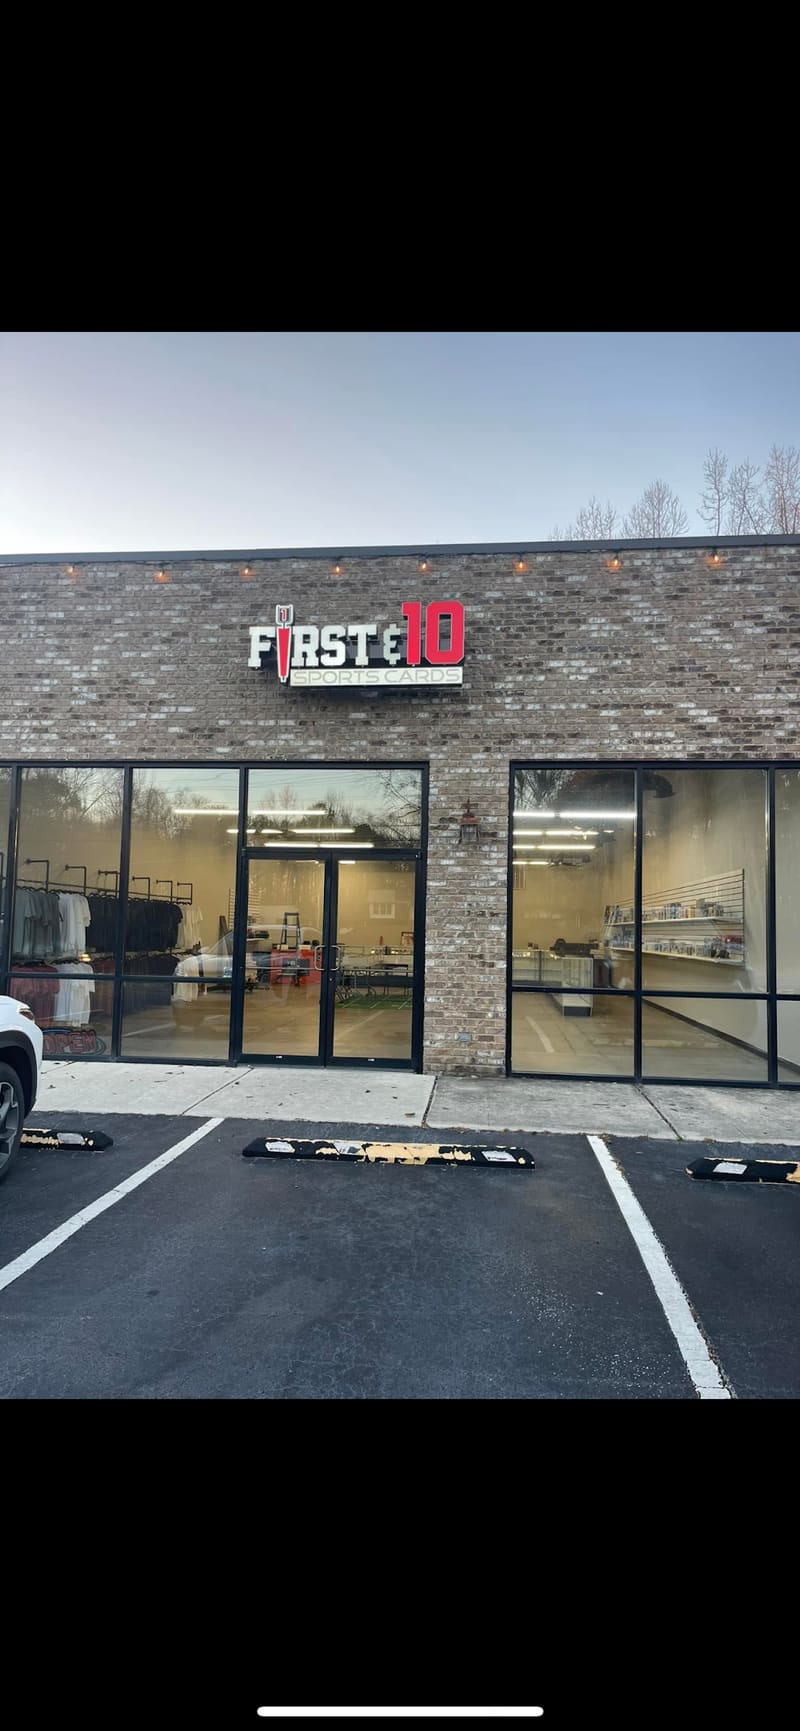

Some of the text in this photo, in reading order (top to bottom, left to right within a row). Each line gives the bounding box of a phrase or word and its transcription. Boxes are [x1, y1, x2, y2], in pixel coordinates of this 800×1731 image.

[248, 600, 464, 683] FIRST & 10
[294, 668, 460, 684] SPORTS CARDS
